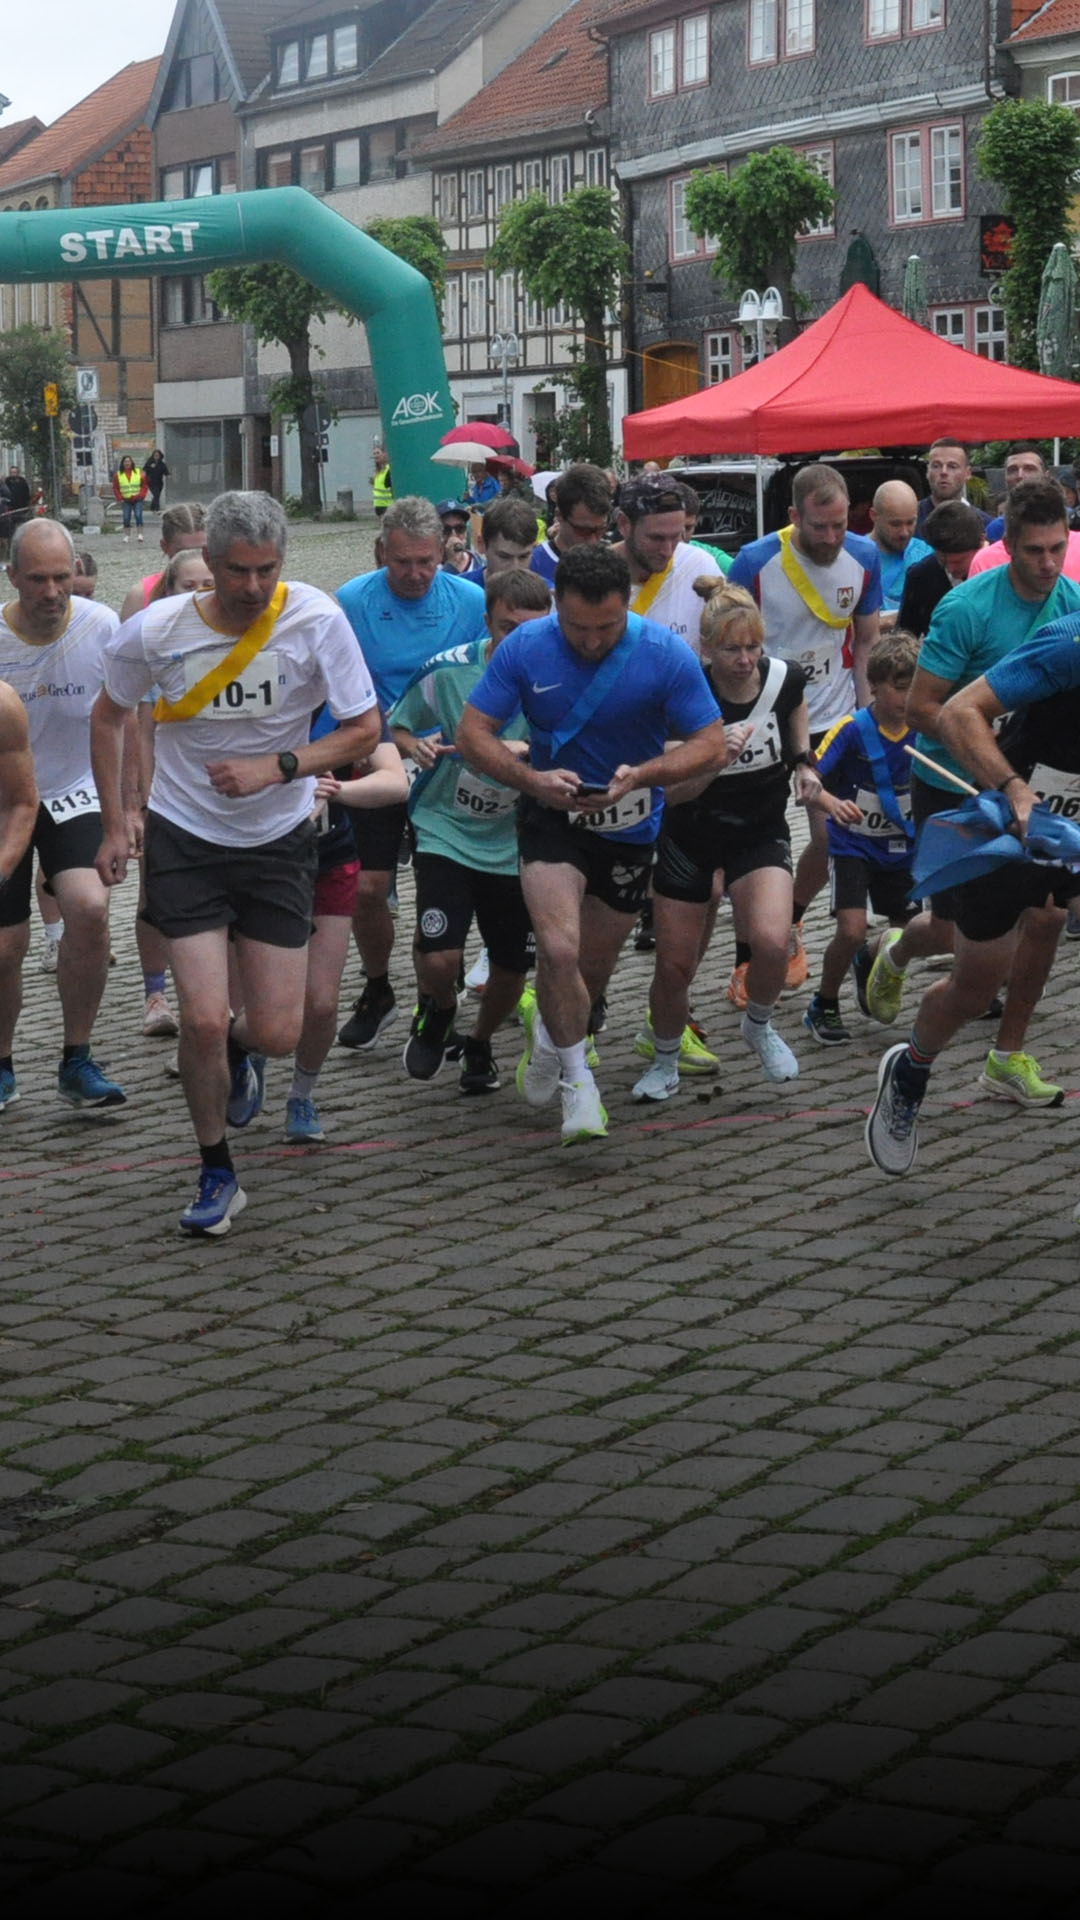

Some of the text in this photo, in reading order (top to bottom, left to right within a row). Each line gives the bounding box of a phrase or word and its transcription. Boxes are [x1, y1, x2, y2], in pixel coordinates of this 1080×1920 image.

[60, 221, 200, 263] START
[391, 390, 443, 420] AOK
[47, 682, 85, 697] GreCon
[732, 737, 778, 765] 6-1
